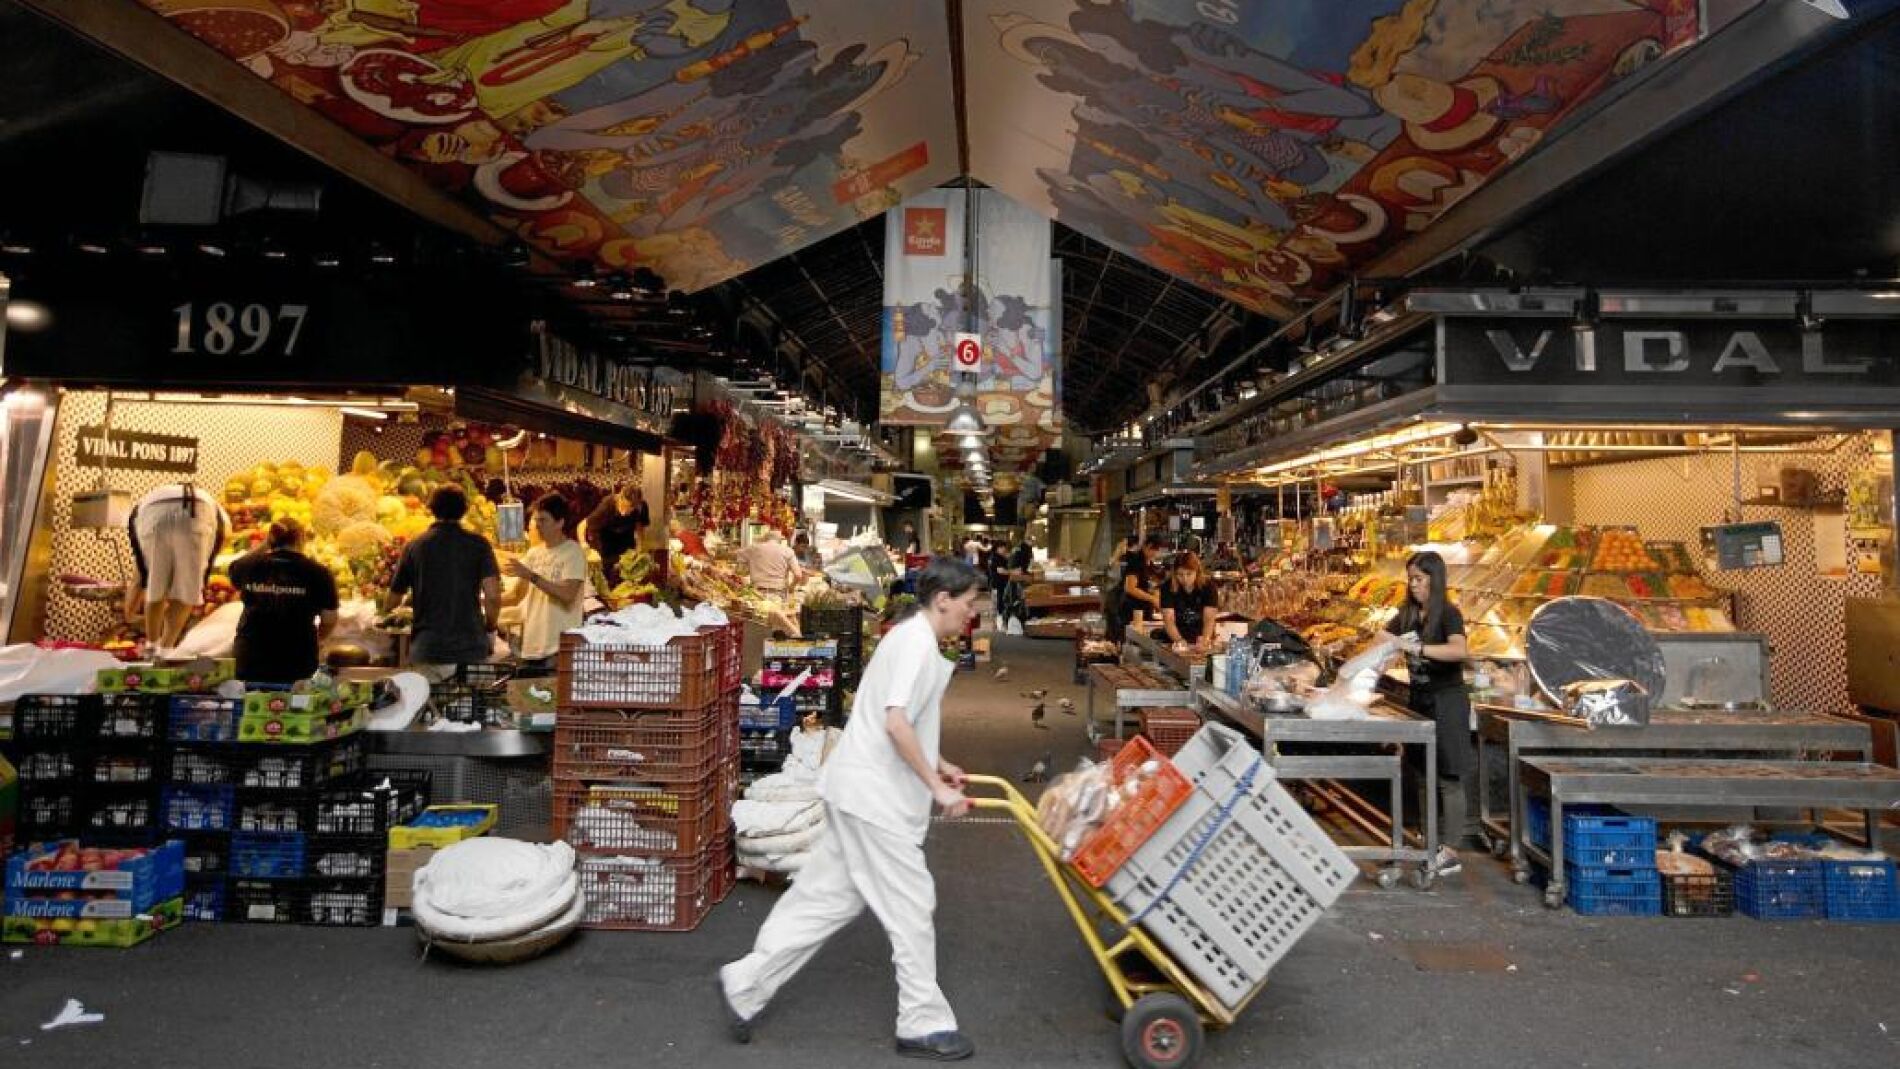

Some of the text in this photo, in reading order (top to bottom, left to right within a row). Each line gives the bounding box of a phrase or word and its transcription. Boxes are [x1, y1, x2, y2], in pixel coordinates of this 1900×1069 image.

[170, 302, 308, 355] 1897
[963, 343, 974, 362] 6
[1485, 329, 1869, 374] VIDAL
[83, 436, 128, 458] VIDAL
[131, 441, 167, 462] PONS
[12, 871, 76, 889] Marlene
[12, 900, 75, 917] Marlene
